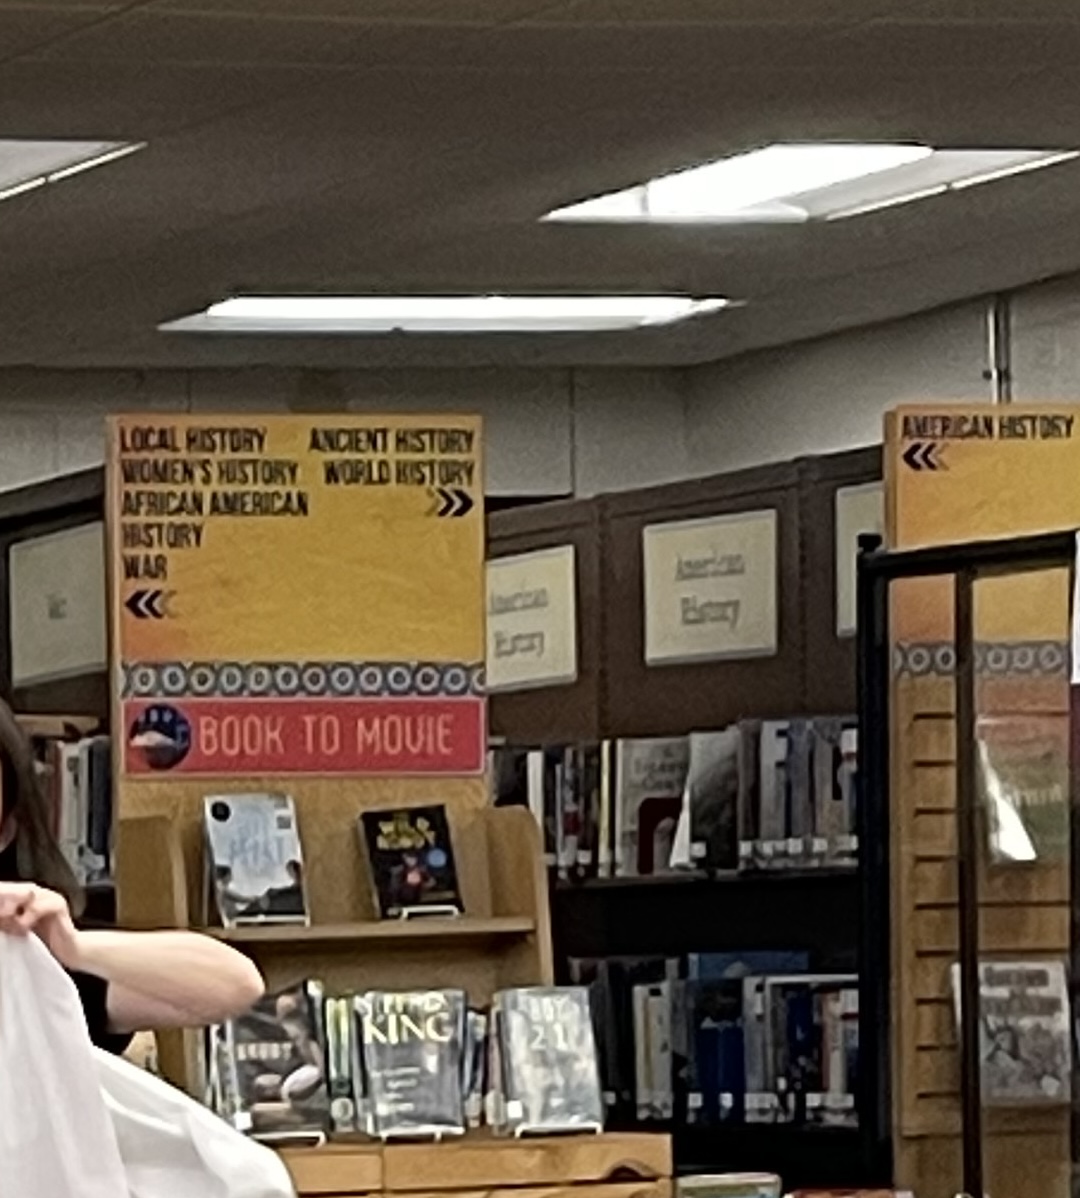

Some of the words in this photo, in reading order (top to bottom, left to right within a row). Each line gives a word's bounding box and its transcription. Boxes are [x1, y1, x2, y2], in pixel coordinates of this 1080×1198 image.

[121, 426, 180, 453] LOCAL
[186, 426, 268, 453] HISTORY
[309, 426, 388, 453] ANCIENT
[395, 427, 474, 454] HISTORY
[902, 414, 993, 440] AMERICAN
[999, 414, 1074, 440] HISTORY
[121, 458, 211, 485] WOMEN'S
[218, 458, 298, 485] HISTORY
[324, 459, 390, 486] WORLD
[395, 459, 474, 487] HISTORY
[122, 489, 203, 516] AFRICAN
[209, 489, 308, 517] AMERICAN
[122, 522, 203, 548] HISTORY
[123, 554, 168, 580] WAR
[200, 714, 285, 756] BOOK
[301, 714, 340, 755] TO
[356, 713, 455, 755] MOVIE
[363, 1010, 455, 1045] KING
